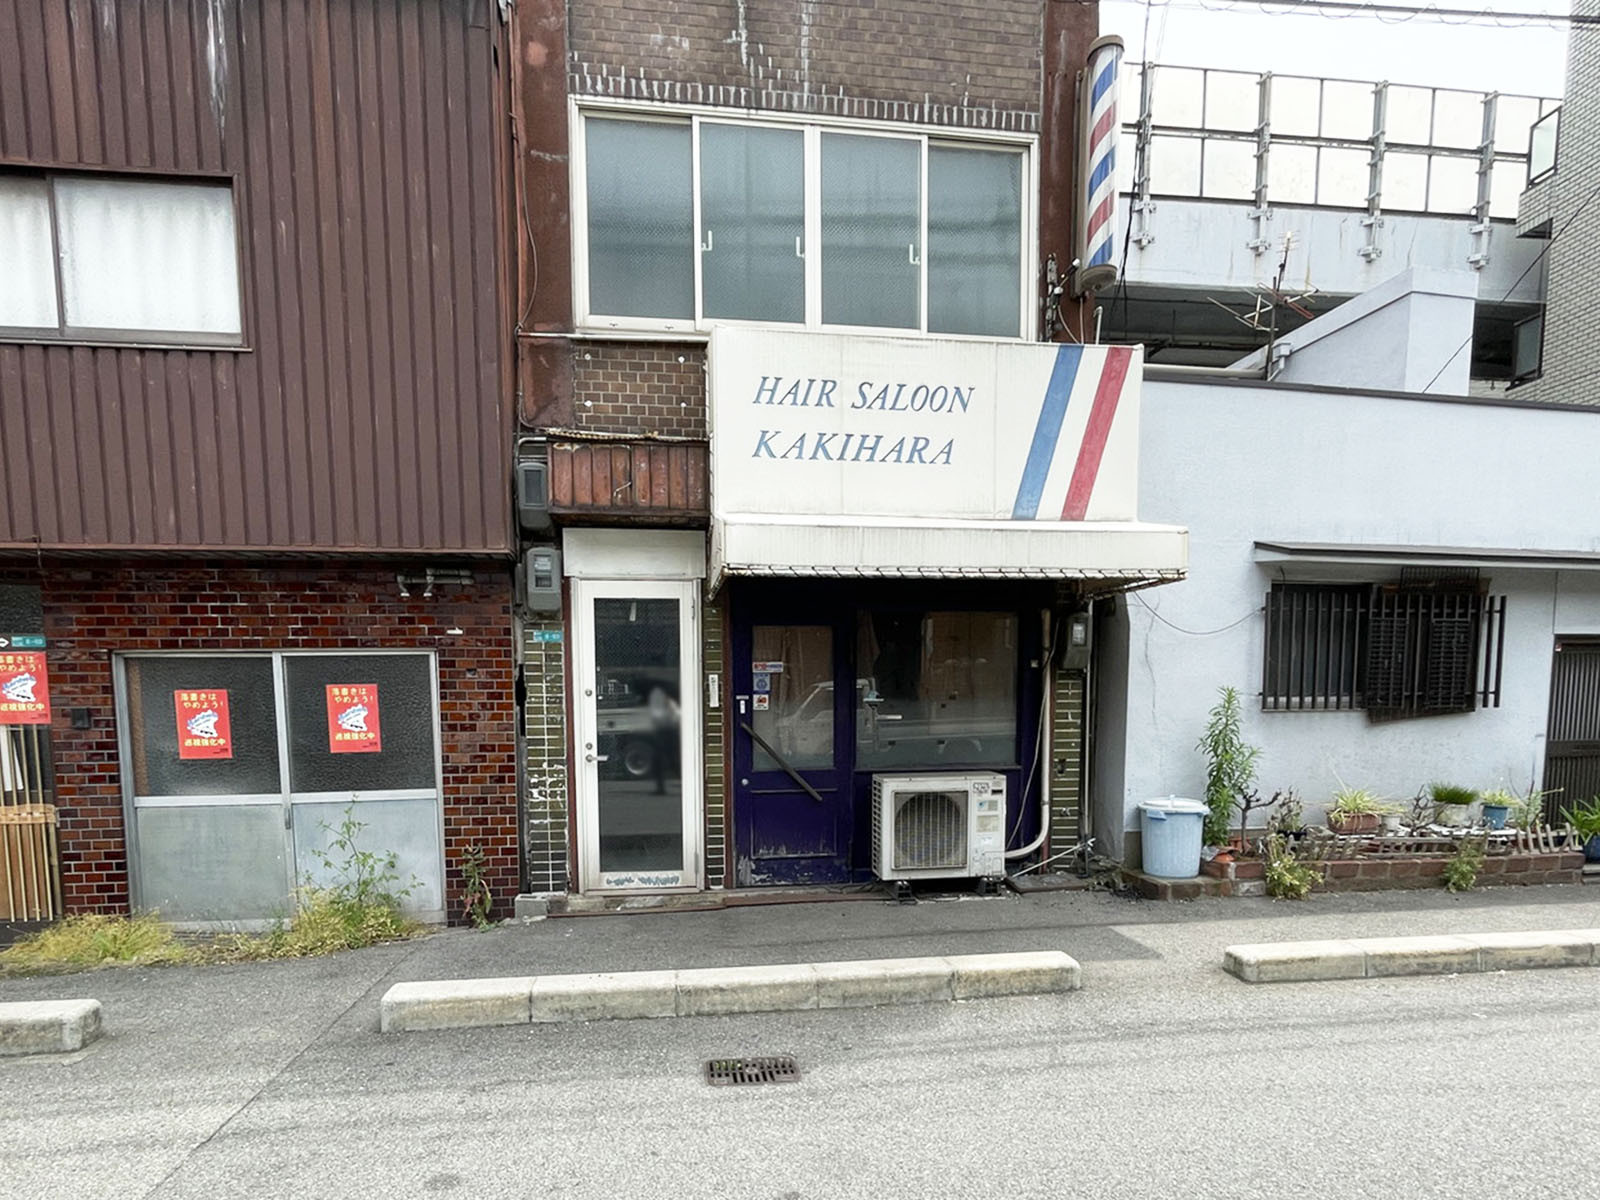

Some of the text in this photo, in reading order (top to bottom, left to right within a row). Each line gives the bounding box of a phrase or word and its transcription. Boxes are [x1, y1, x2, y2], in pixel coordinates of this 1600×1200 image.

[752, 376, 975, 413] HAIR SALOON
[751, 430, 955, 465] KAKIHARA
